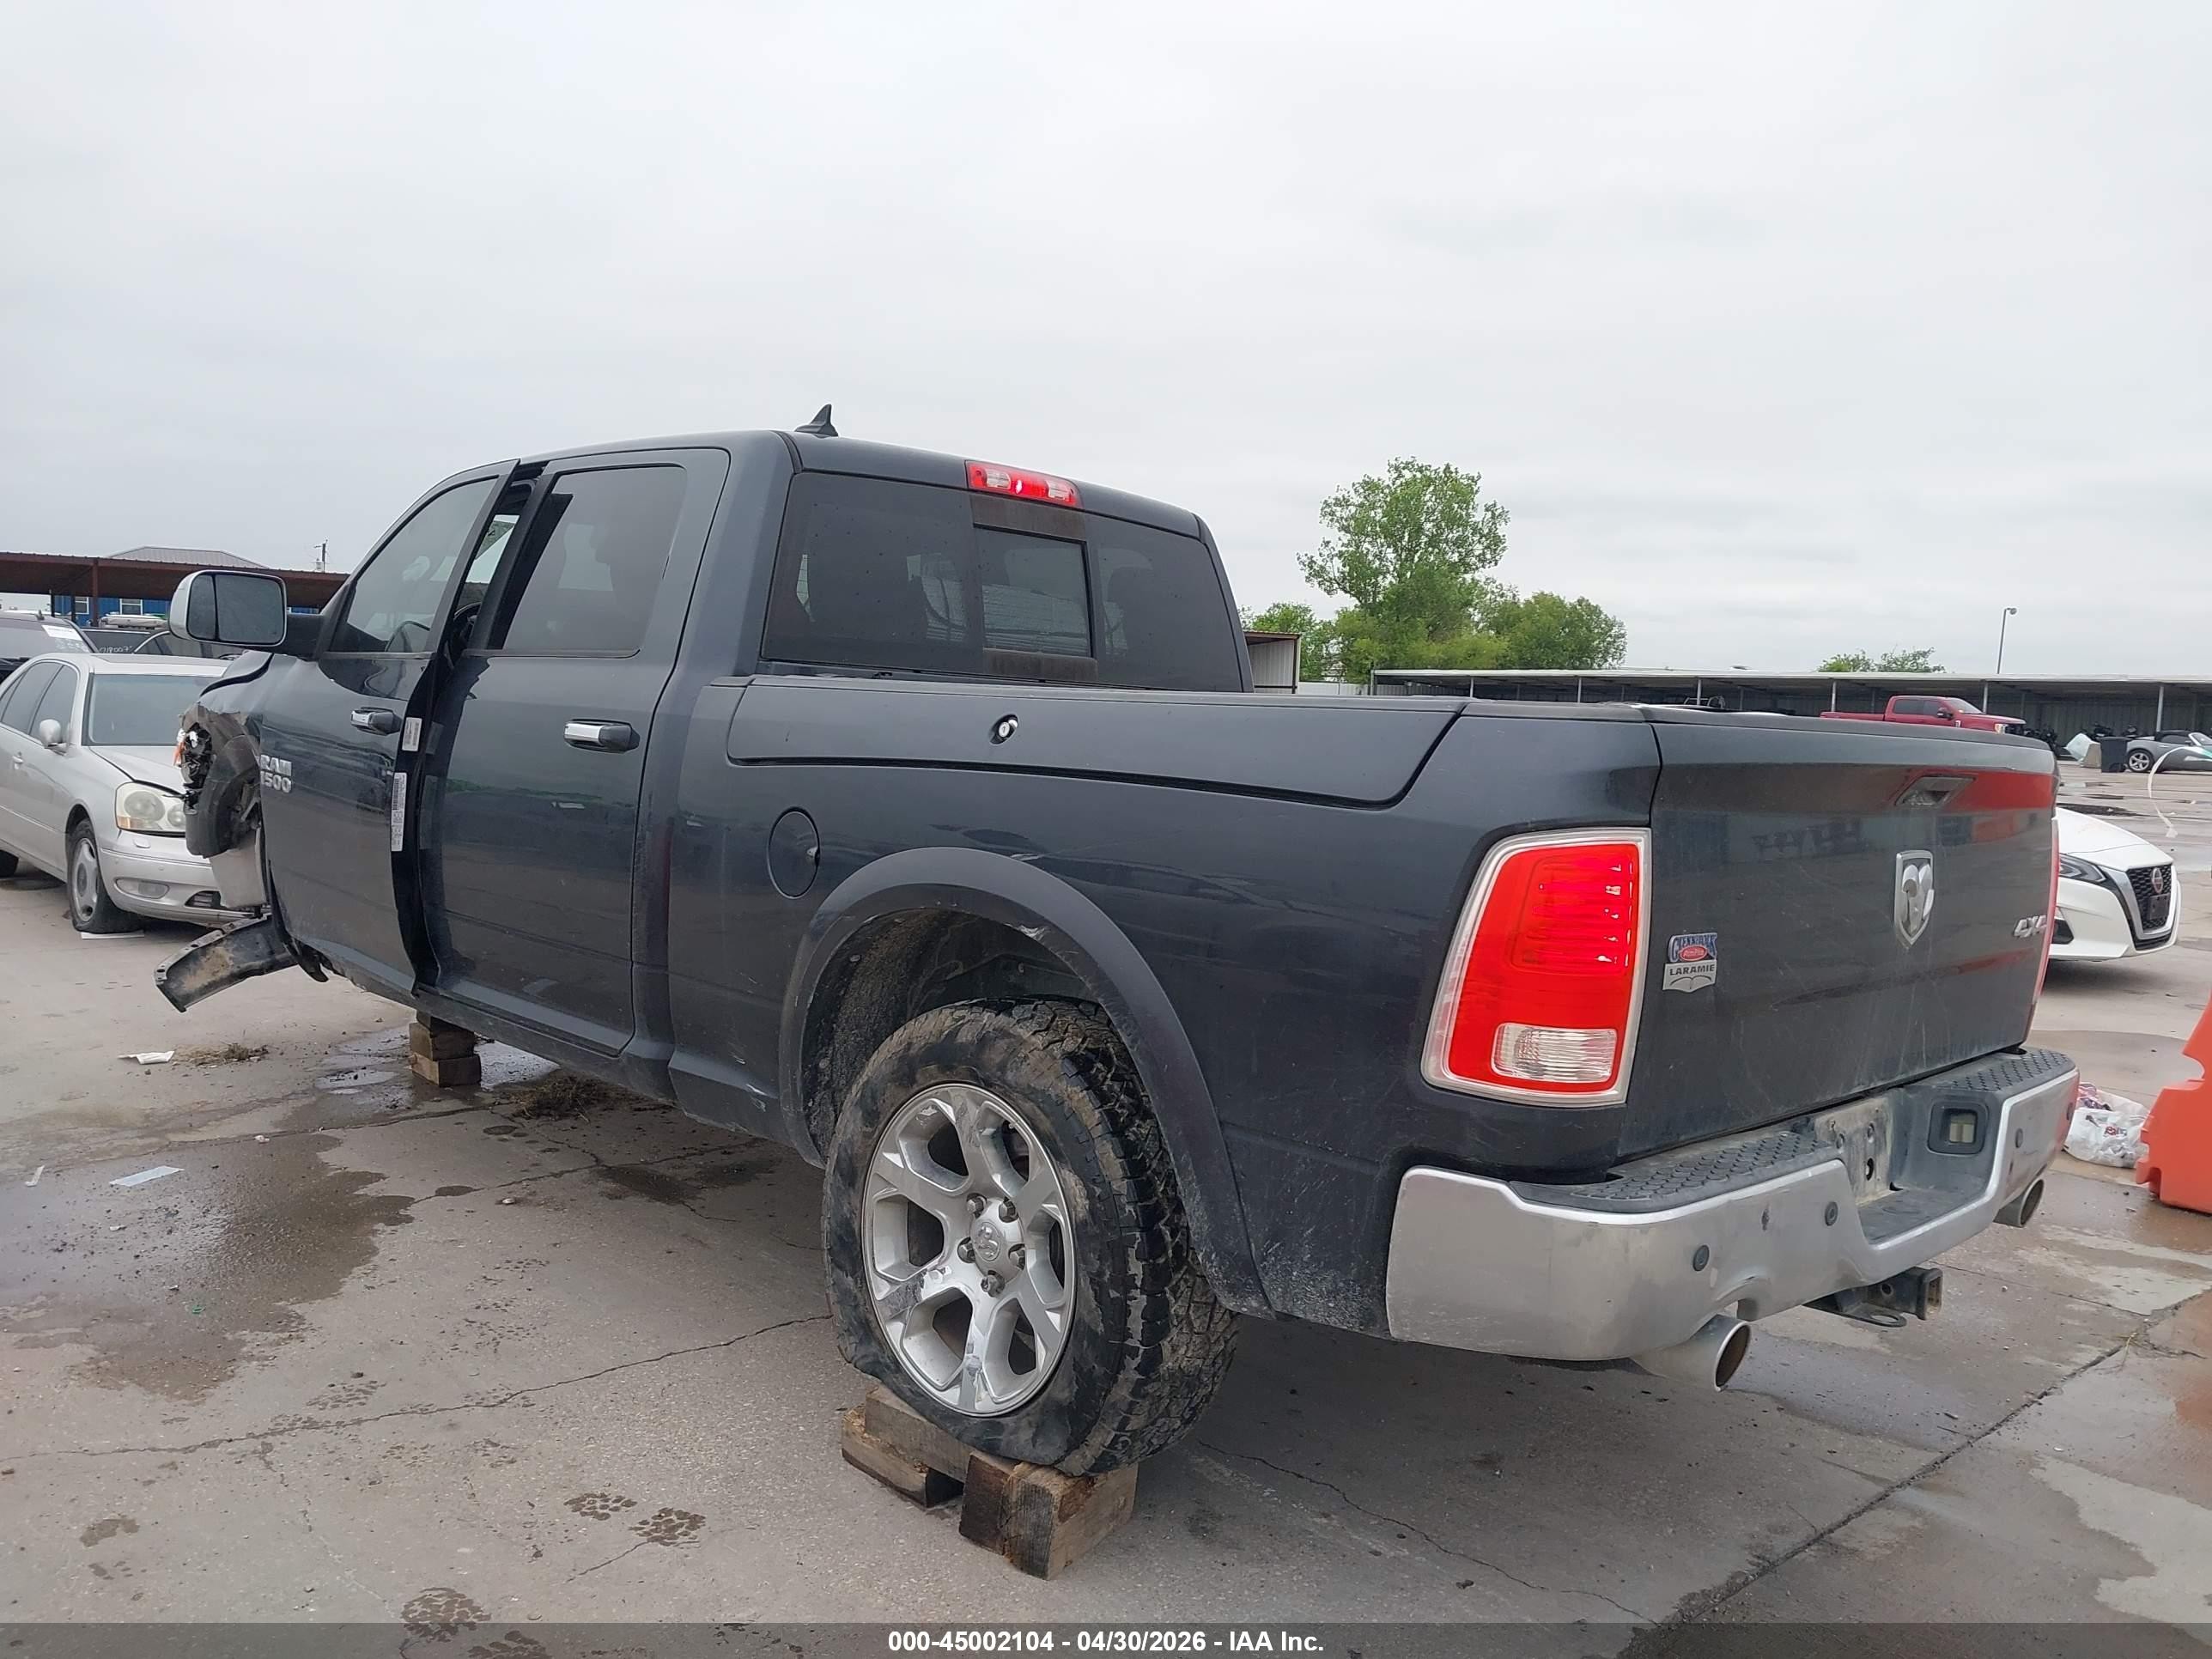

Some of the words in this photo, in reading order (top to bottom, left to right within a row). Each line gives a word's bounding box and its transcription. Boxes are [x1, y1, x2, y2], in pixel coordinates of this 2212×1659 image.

[260, 754, 292, 777] RAM
[260, 770, 292, 793] 1500
[1669, 963, 1715, 976] LARAMIE
